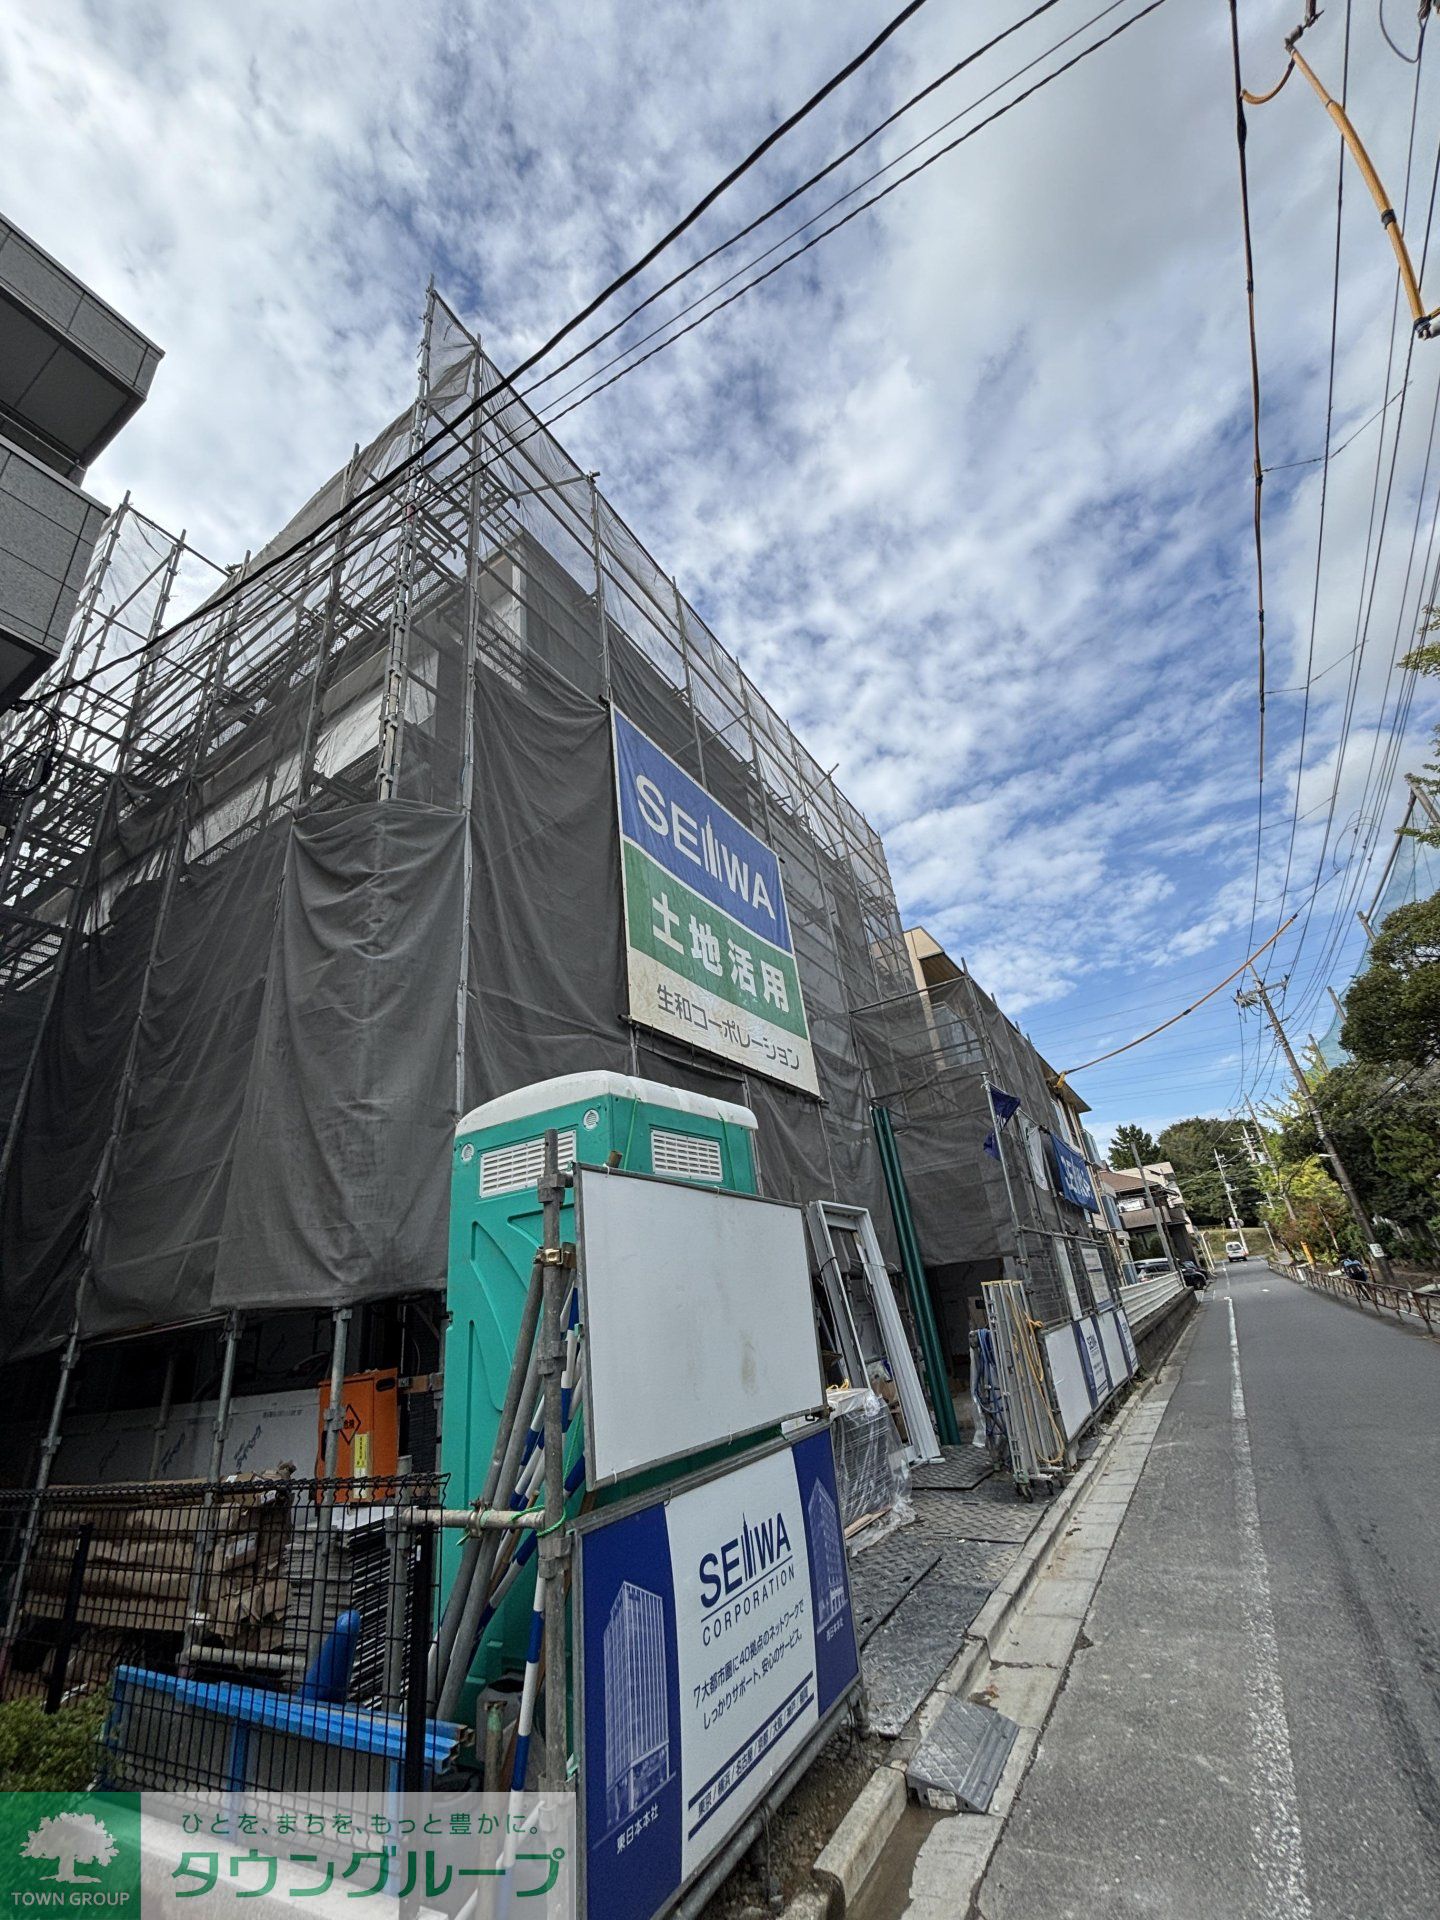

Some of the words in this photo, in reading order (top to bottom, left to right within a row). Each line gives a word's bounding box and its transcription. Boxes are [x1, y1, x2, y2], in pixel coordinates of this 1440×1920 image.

[635, 774, 776, 920] SEIWA
[652, 892, 790, 1013] 土地活用
[657, 983, 800, 1070] 生和コーポレーション
[699, 1512, 792, 1609] SEIWA
[702, 1563, 796, 1648] CORPORATION
[616, 1802, 659, 1855] 東日本本社
